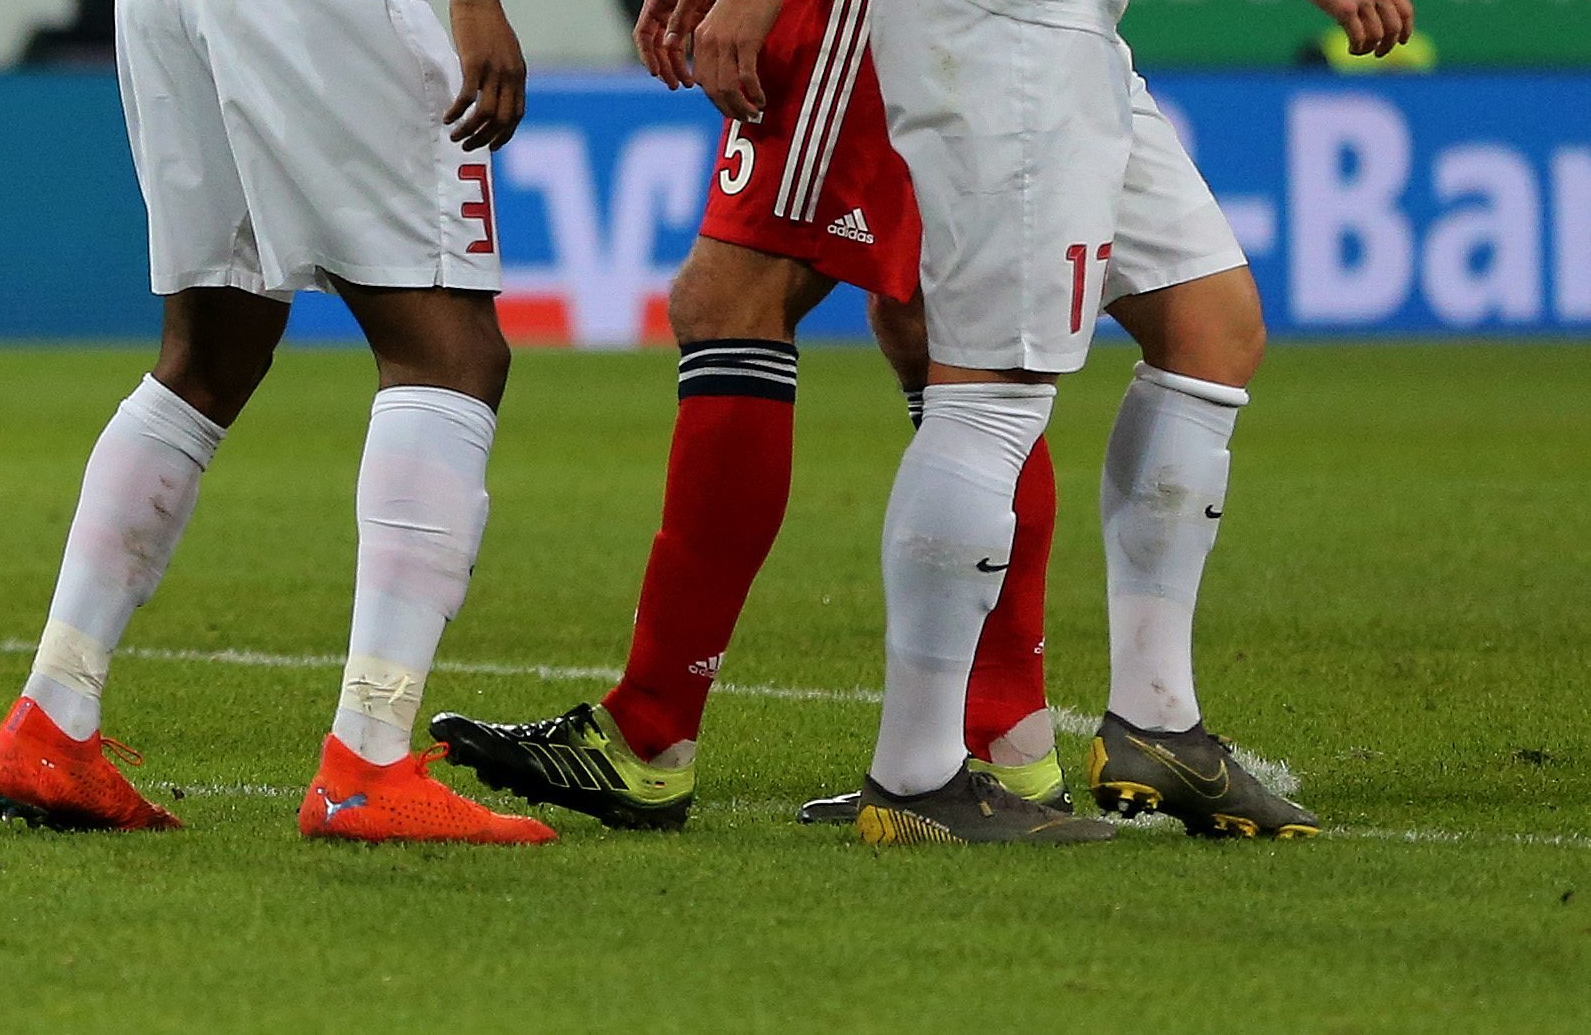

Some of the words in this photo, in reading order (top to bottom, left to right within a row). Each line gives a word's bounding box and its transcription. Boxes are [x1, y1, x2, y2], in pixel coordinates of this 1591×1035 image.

[719, 111, 764, 196] 5
[457, 164, 494, 253] 3
[827, 223, 874, 244] adidas
